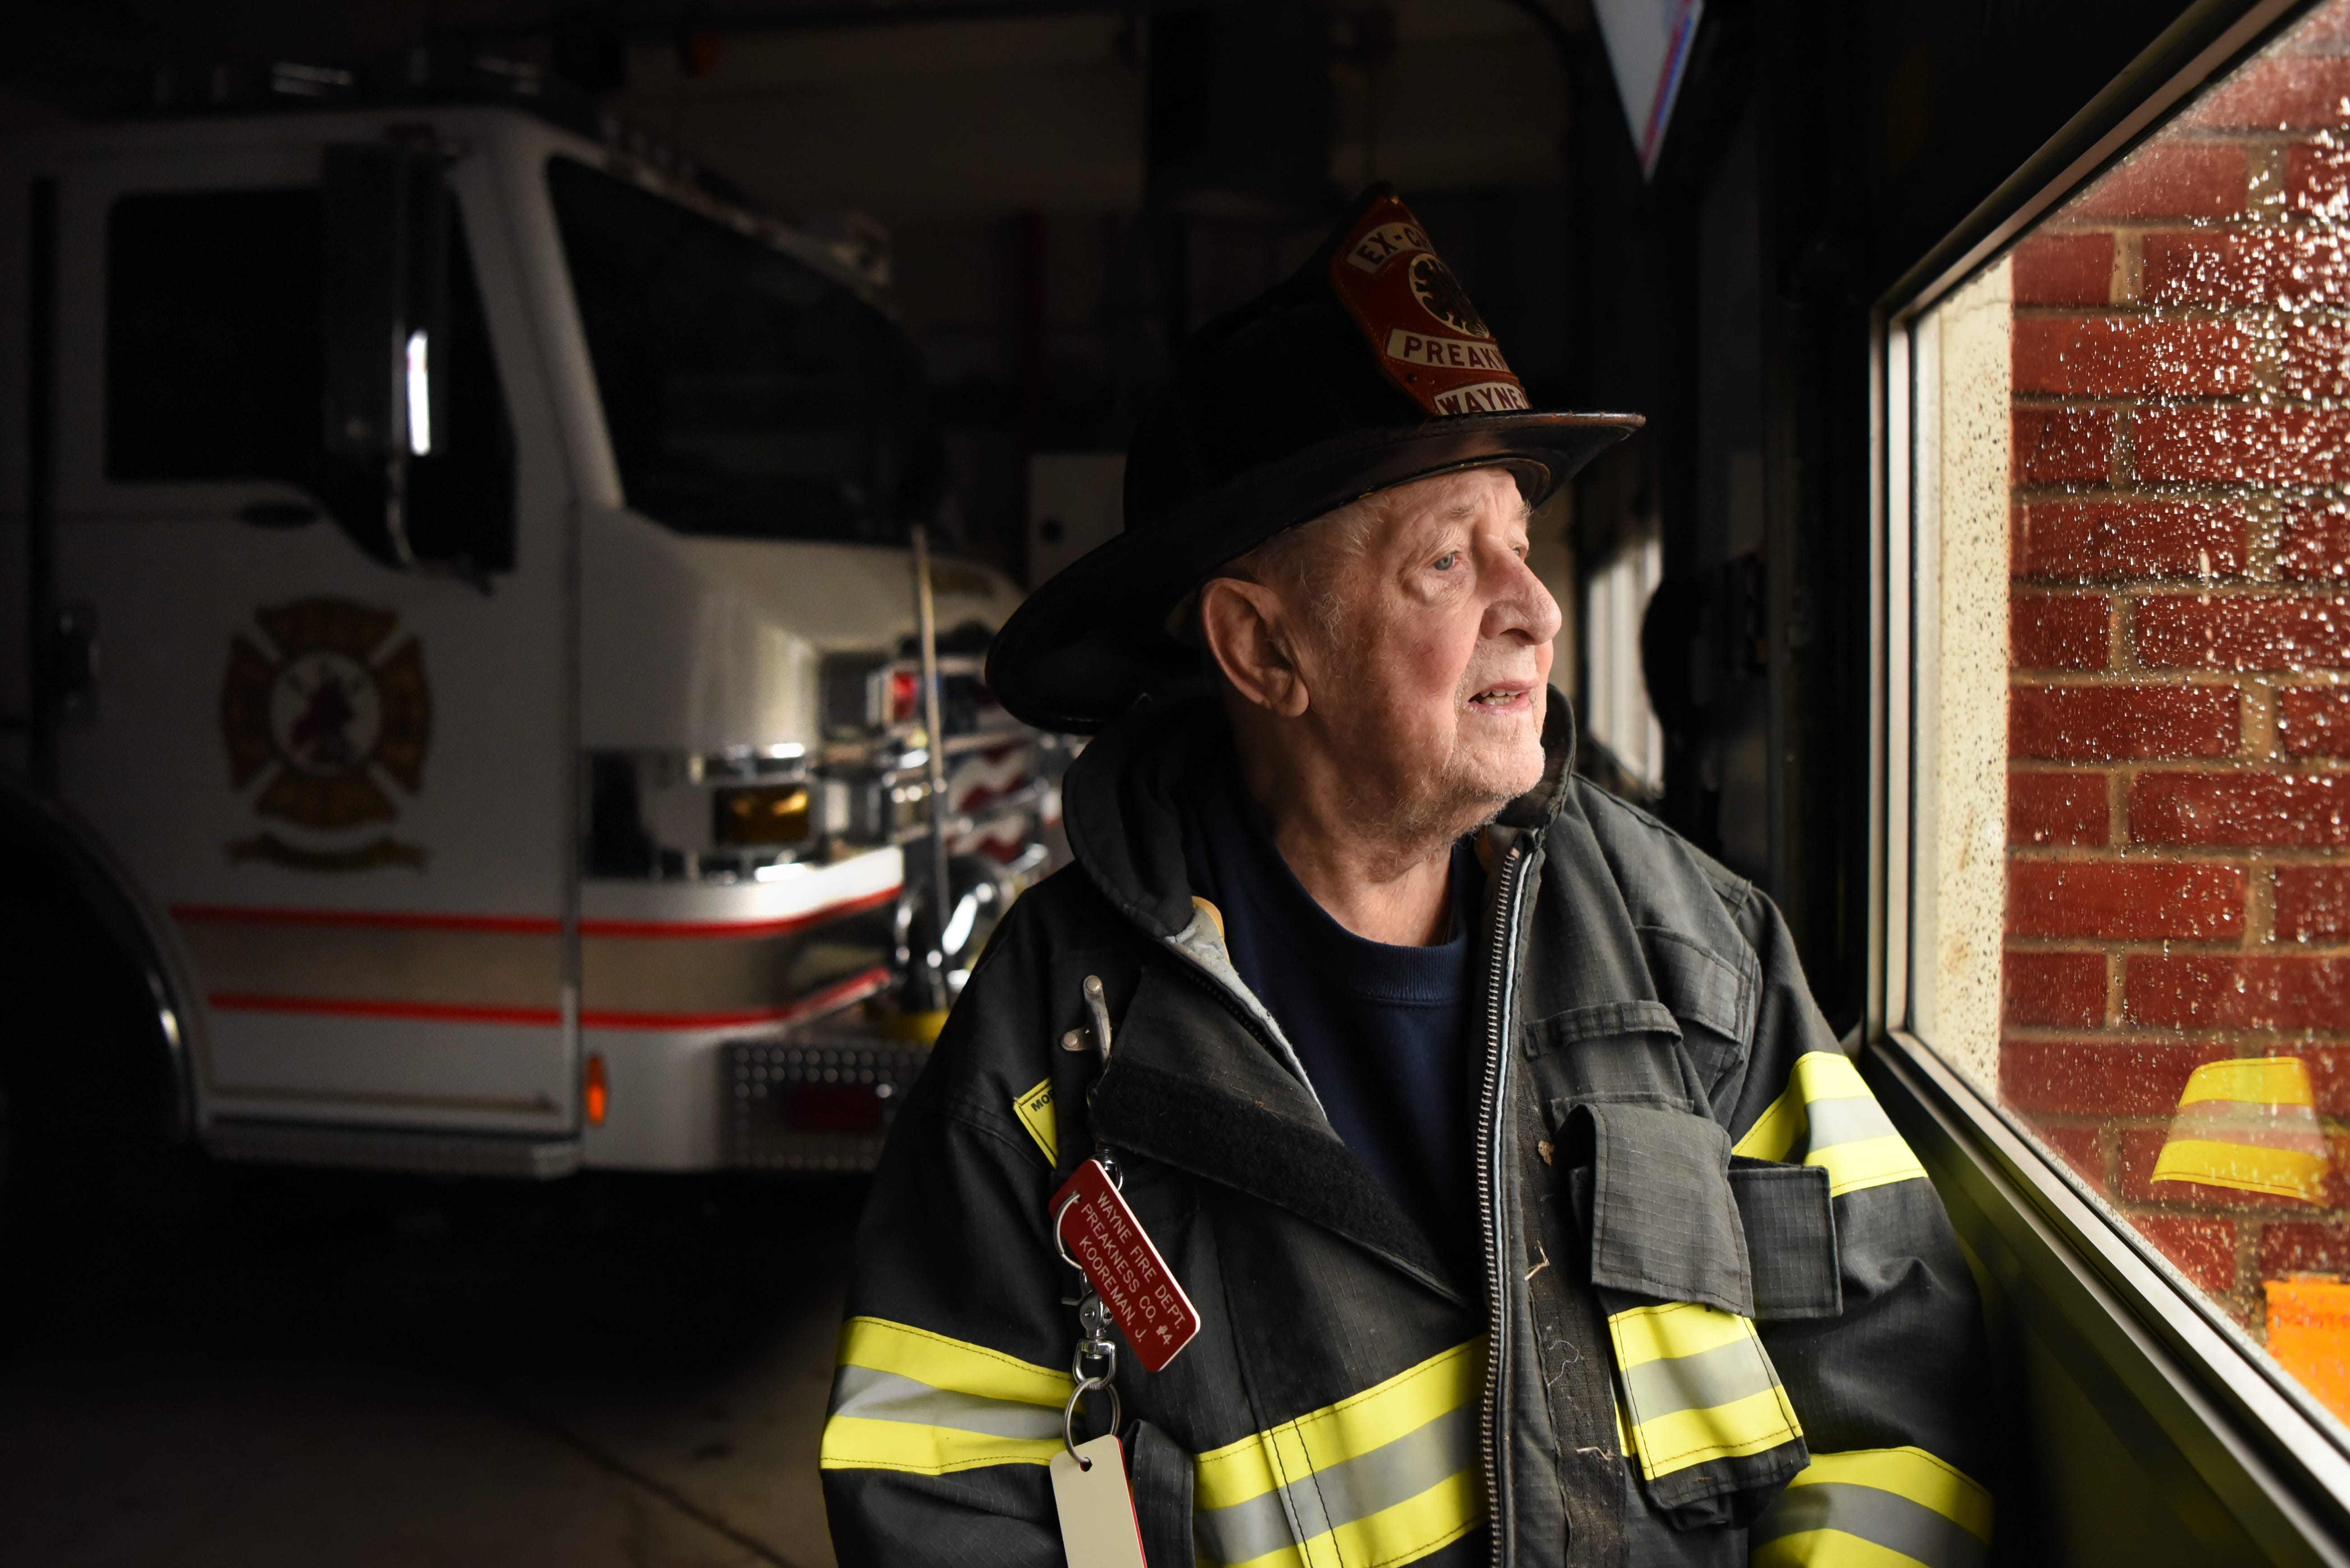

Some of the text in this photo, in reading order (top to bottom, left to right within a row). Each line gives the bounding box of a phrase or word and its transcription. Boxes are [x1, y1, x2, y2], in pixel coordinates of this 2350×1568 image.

[1438, 387, 1523, 414] WAYNE
[1081, 1203, 1173, 1345] PREAKNESS CO. #4
[1097, 1191, 1186, 1330] WAYNE FIRE DEPT.
[1135, 1328, 1147, 1343] J.
